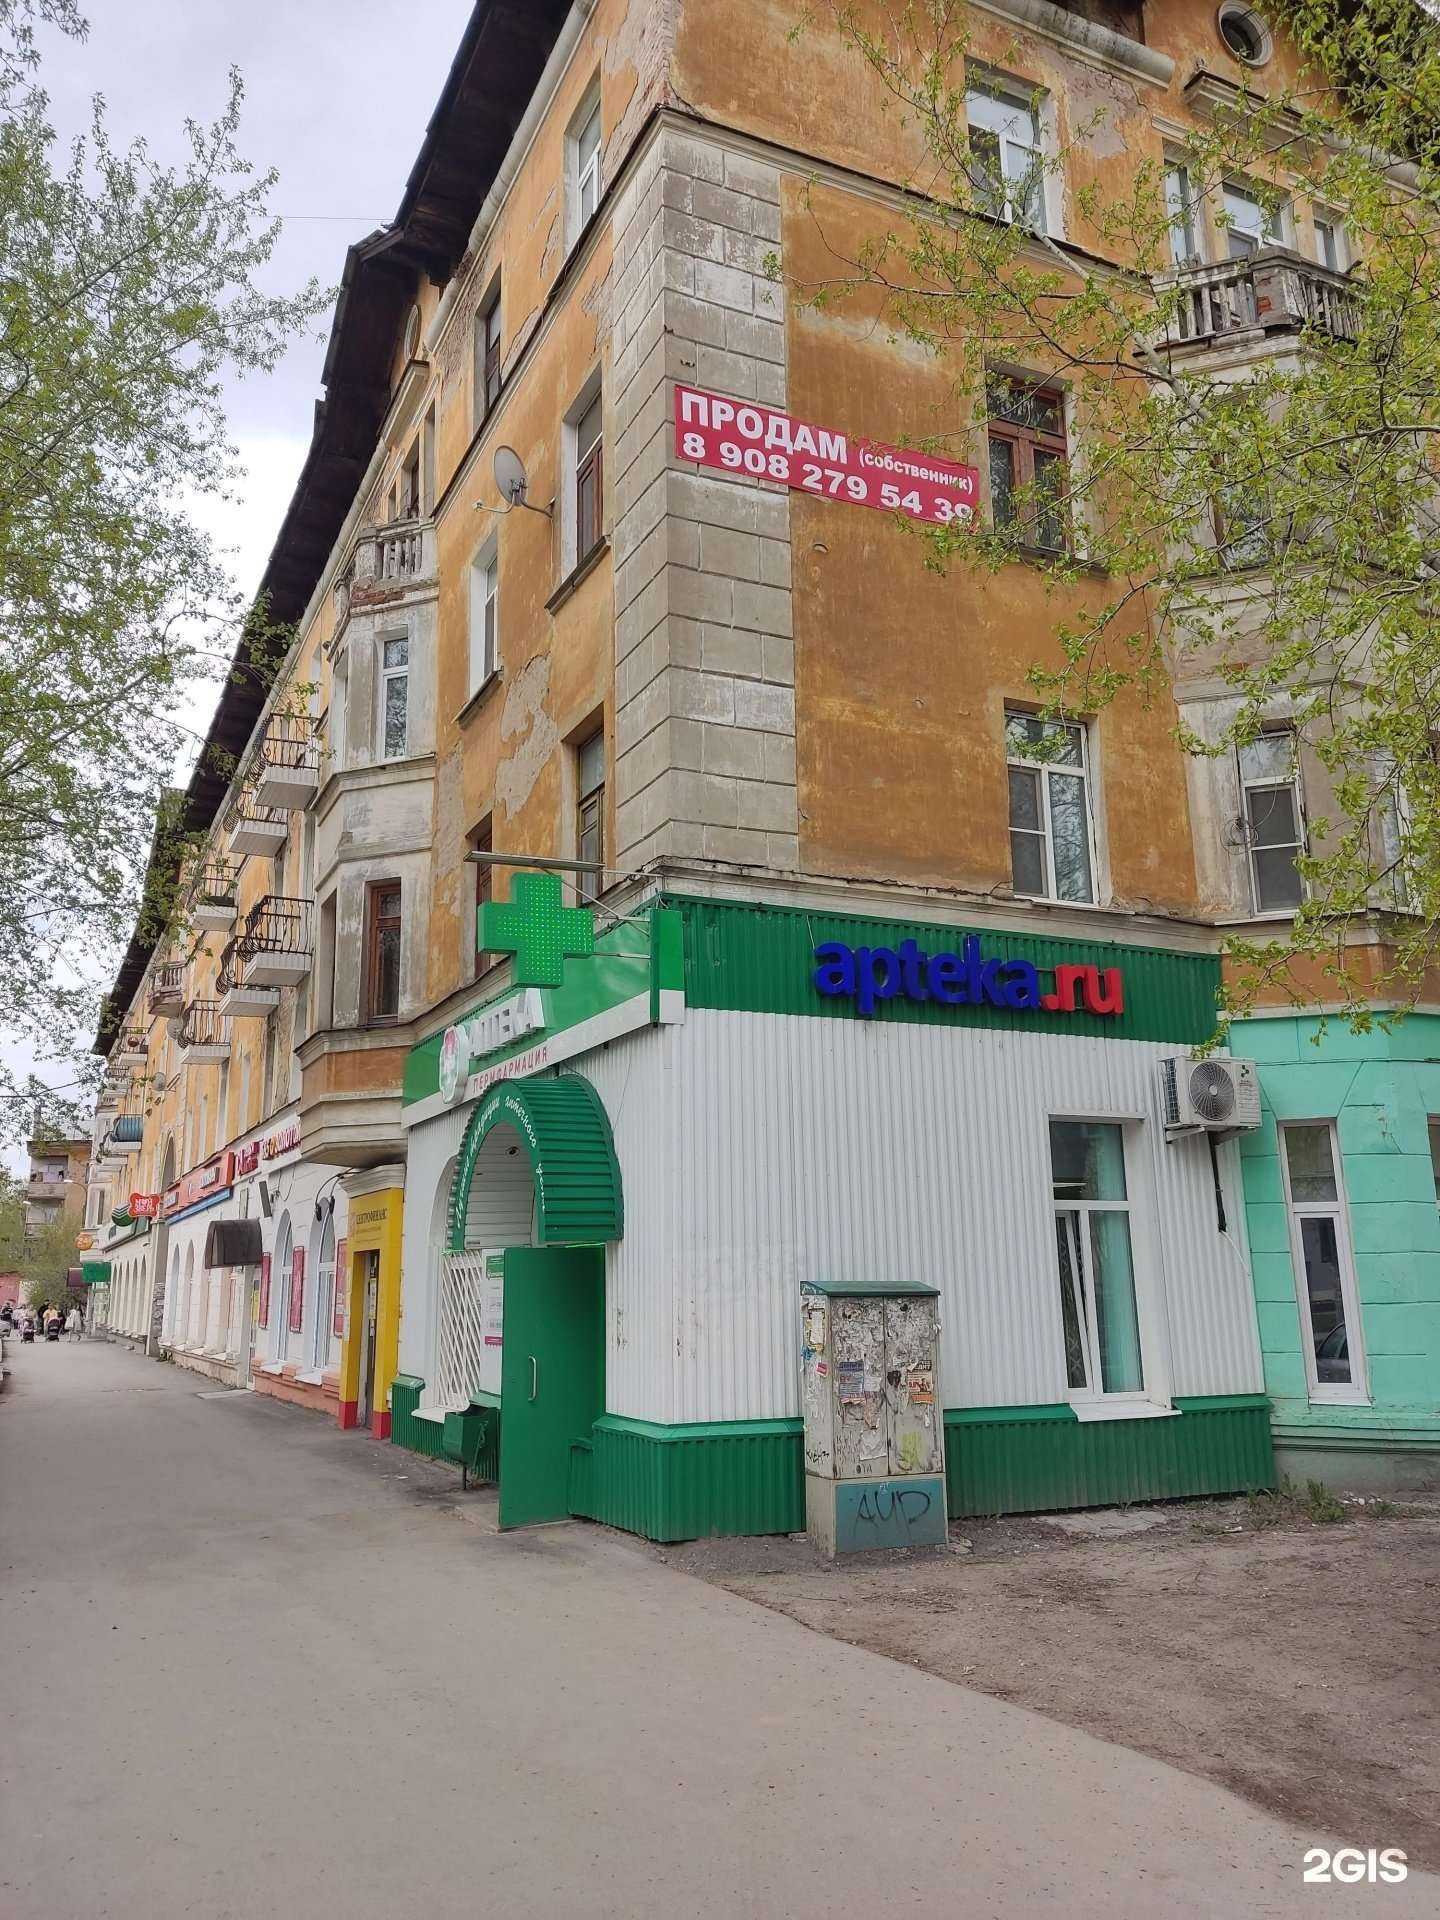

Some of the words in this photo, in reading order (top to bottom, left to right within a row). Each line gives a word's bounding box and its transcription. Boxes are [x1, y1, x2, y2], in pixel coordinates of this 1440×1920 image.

[681, 390, 848, 464] ПРОДАМ
[858, 447, 974, 495] (собственник)
[682, 432, 706, 458] 8
[718, 441, 790, 479] 908
[801, 463, 868, 500] 279
[880, 483, 923, 514] 54
[813, 933, 1124, 1015] apteka.ru
